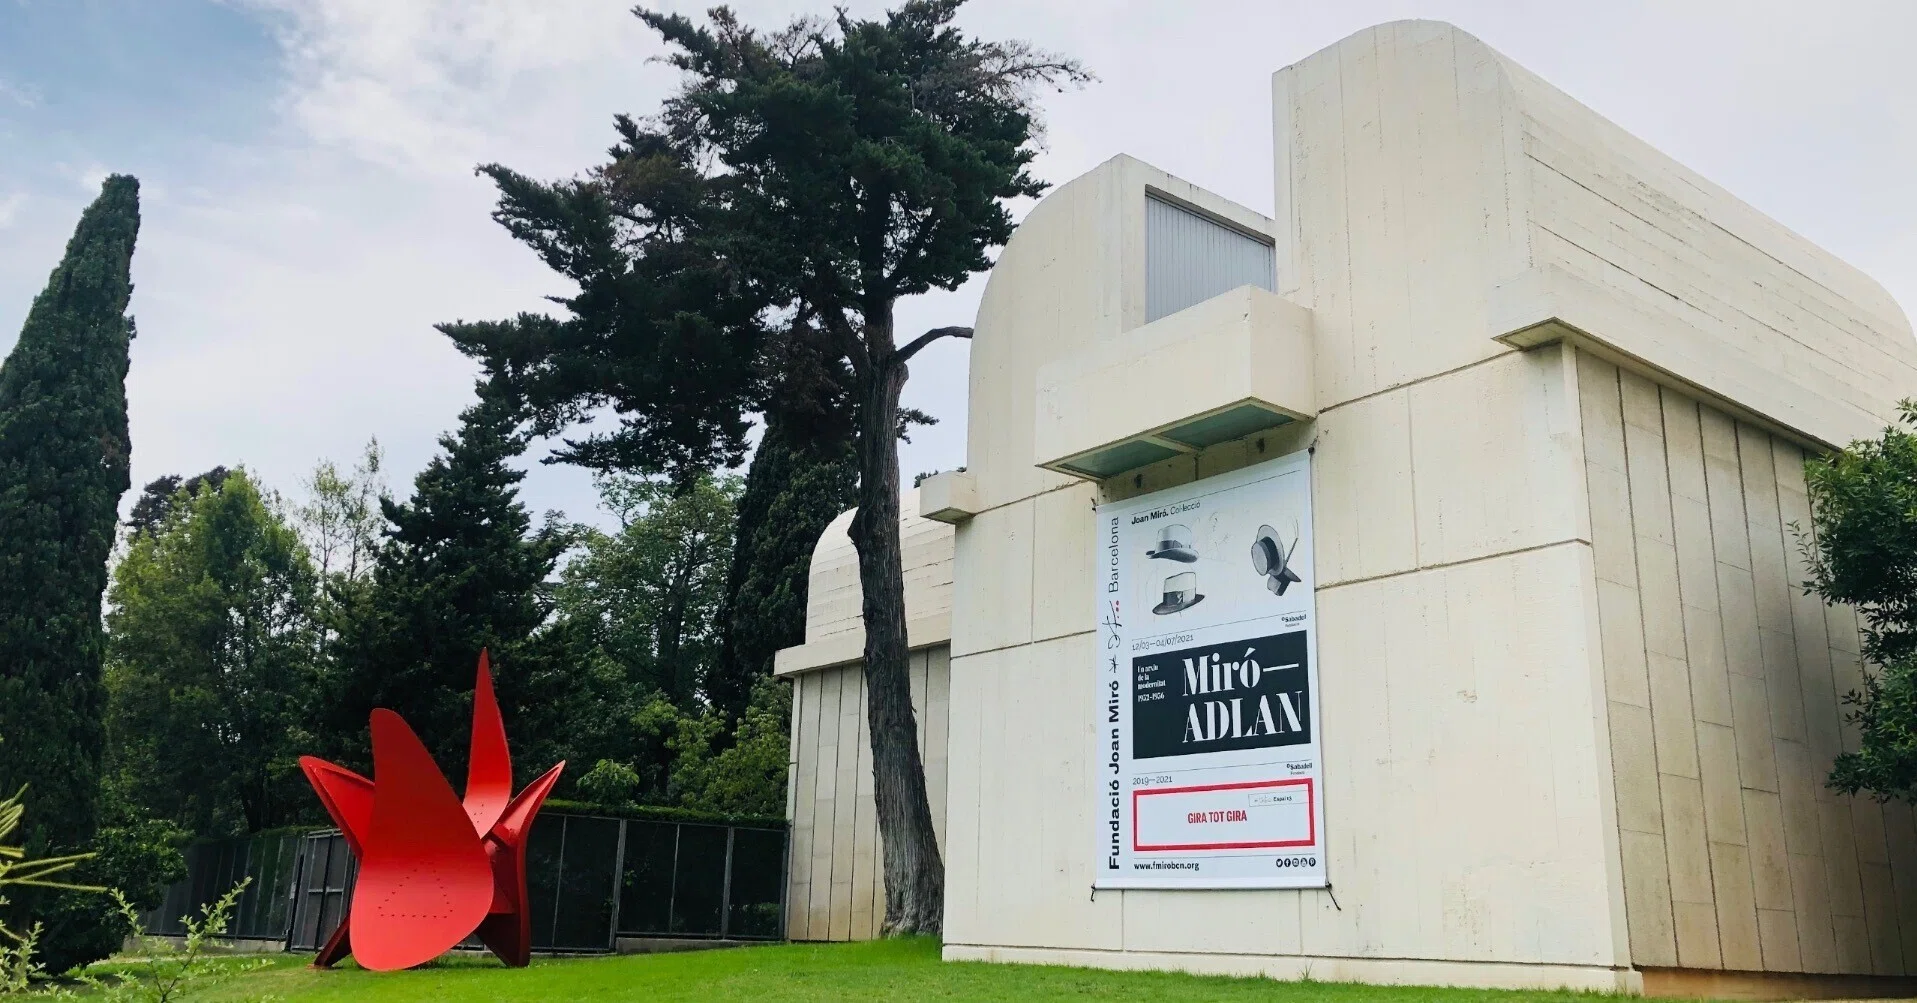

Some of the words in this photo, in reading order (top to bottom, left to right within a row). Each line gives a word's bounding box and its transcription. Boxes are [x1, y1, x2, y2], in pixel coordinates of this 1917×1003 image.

[1131, 515, 1149, 525] Joan
[1108, 516, 1119, 594] Barcelona
[1109, 680, 1120, 723] Miró
[1182, 690, 1303, 744] ADLAN
[1109, 728, 1120, 775] Joan
[1109, 780, 1120, 870] Fundació
[1187, 811, 1208, 824] GIRA
[1208, 811, 1225, 823] TOT
[1226, 810, 1248, 822] GIRA
[1133, 861, 1200, 872] www.fmirobcn.org
